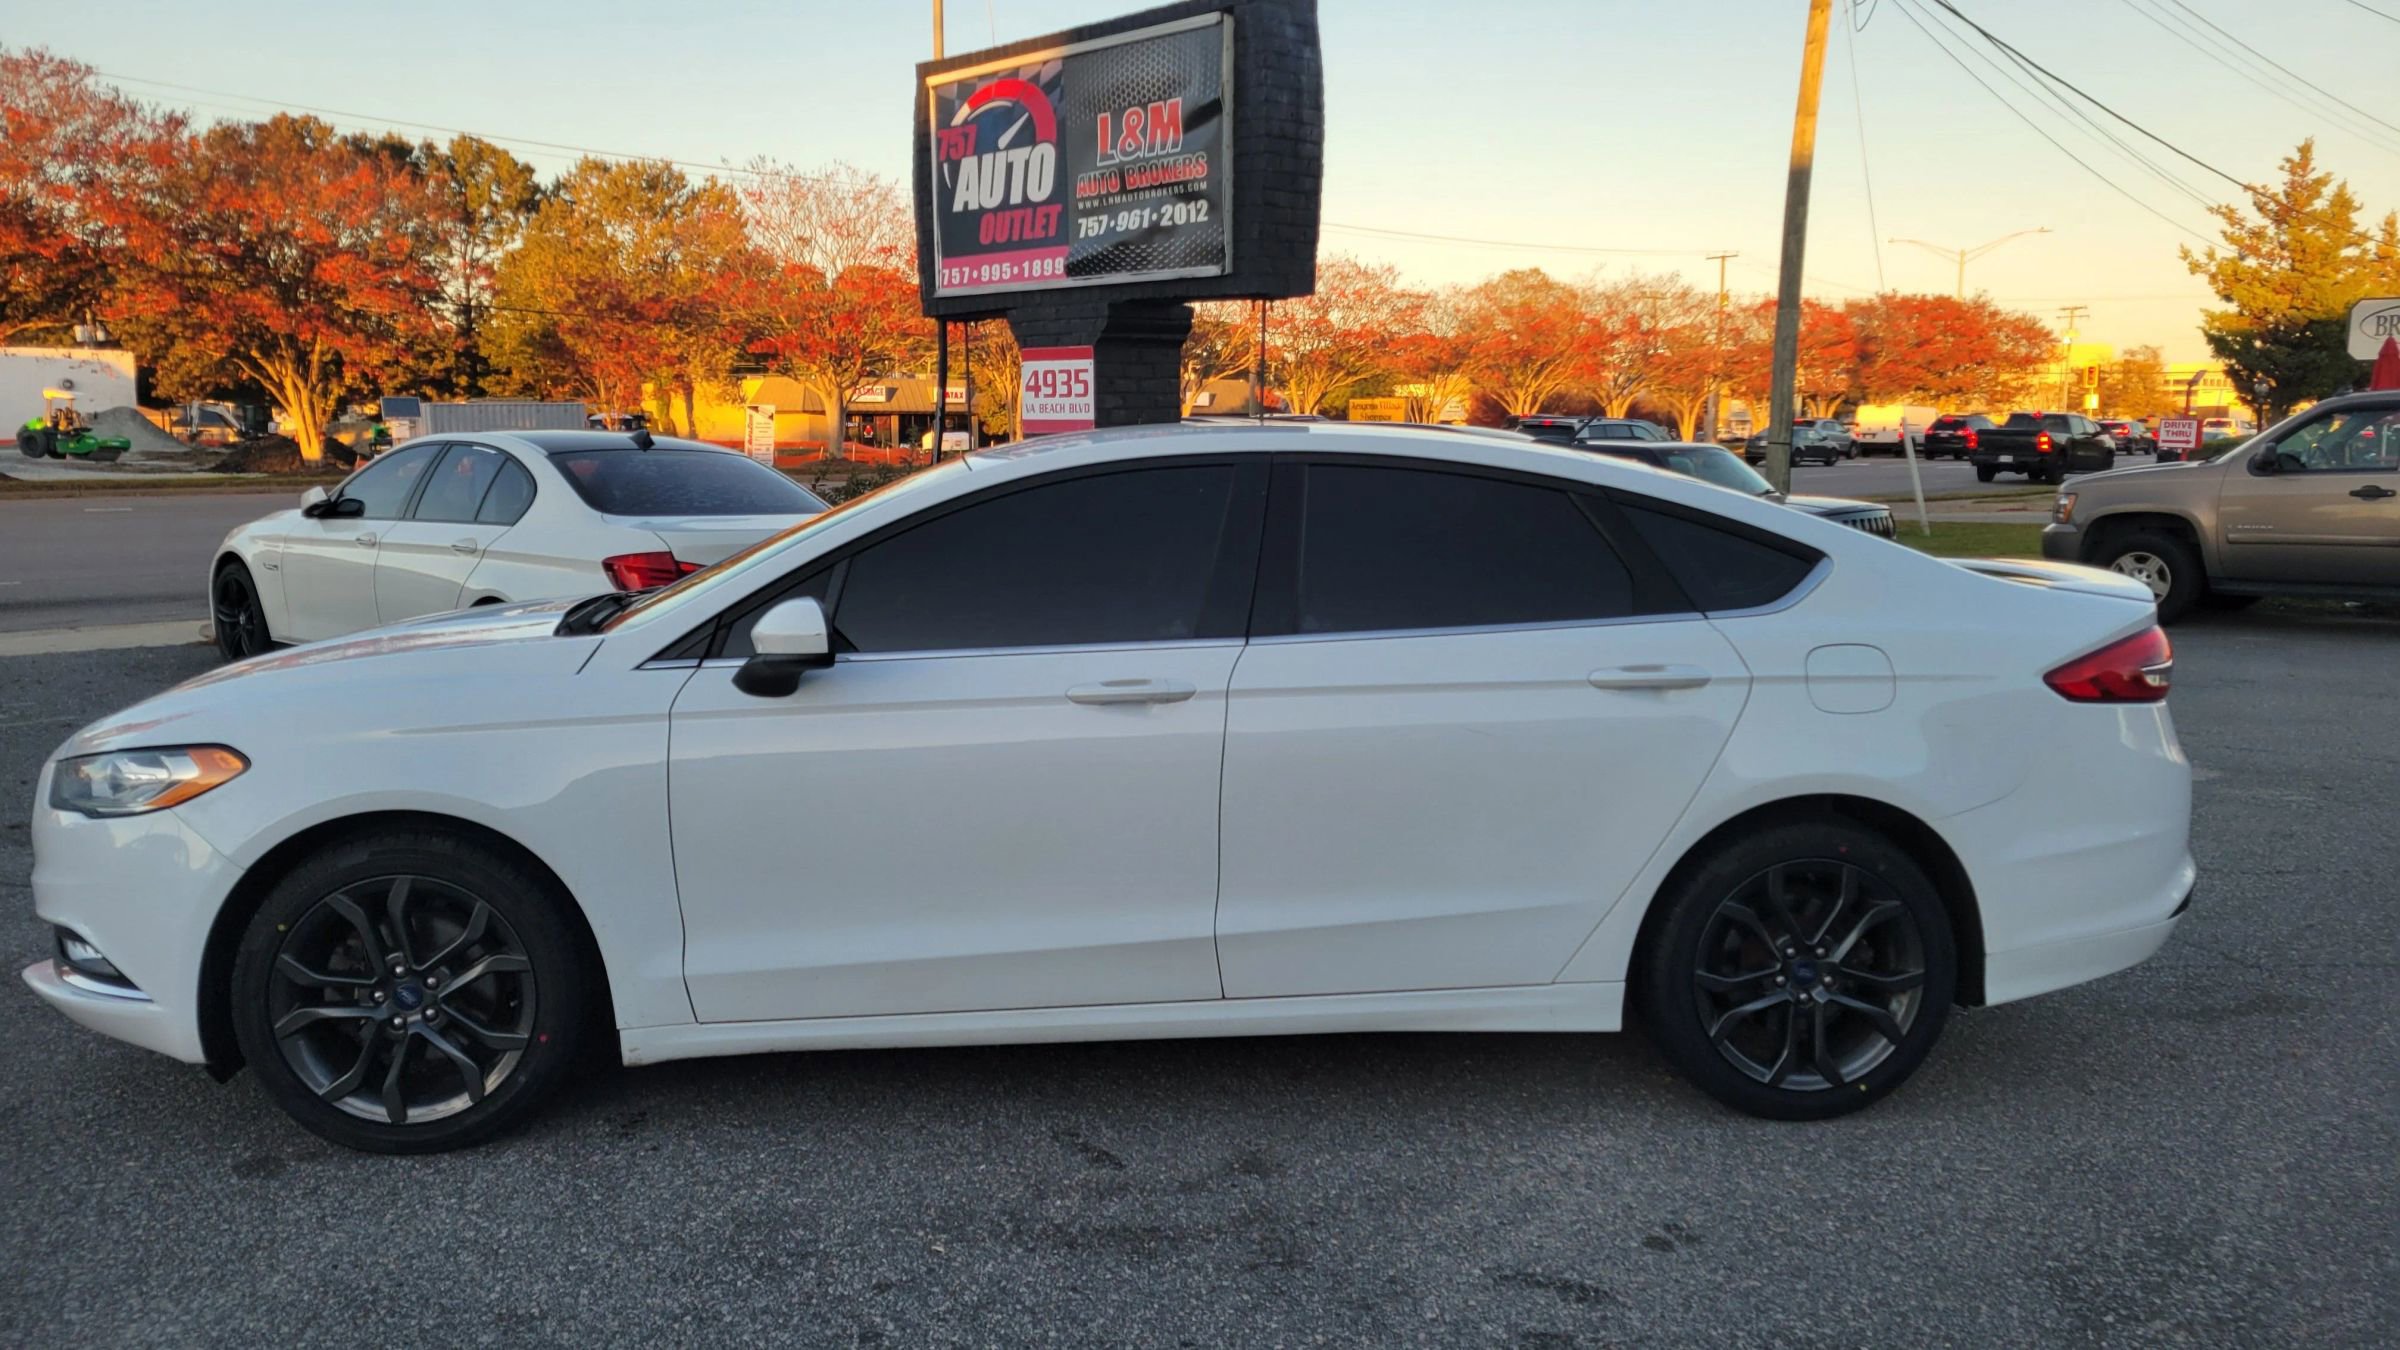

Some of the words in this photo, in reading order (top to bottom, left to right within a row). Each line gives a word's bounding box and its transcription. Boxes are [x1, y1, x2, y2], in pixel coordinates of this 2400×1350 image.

[937, 124, 977, 161] 757
[1097, 97, 1183, 167] L&M
[952, 142, 1056, 213] AUTO
[1076, 167, 1121, 199] AUTO
[1124, 151, 1208, 191] BROKERS
[979, 203, 1063, 245] OUTLET
[1024, 368, 1089, 399] 4935
[1025, 403, 1036, 414] VA
[1039, 403, 1066, 414] BEACH
[1069, 403, 1091, 414] BLVD
[2164, 421, 2193, 430] DRIVE
[2165, 430, 2192, 438] THRU
